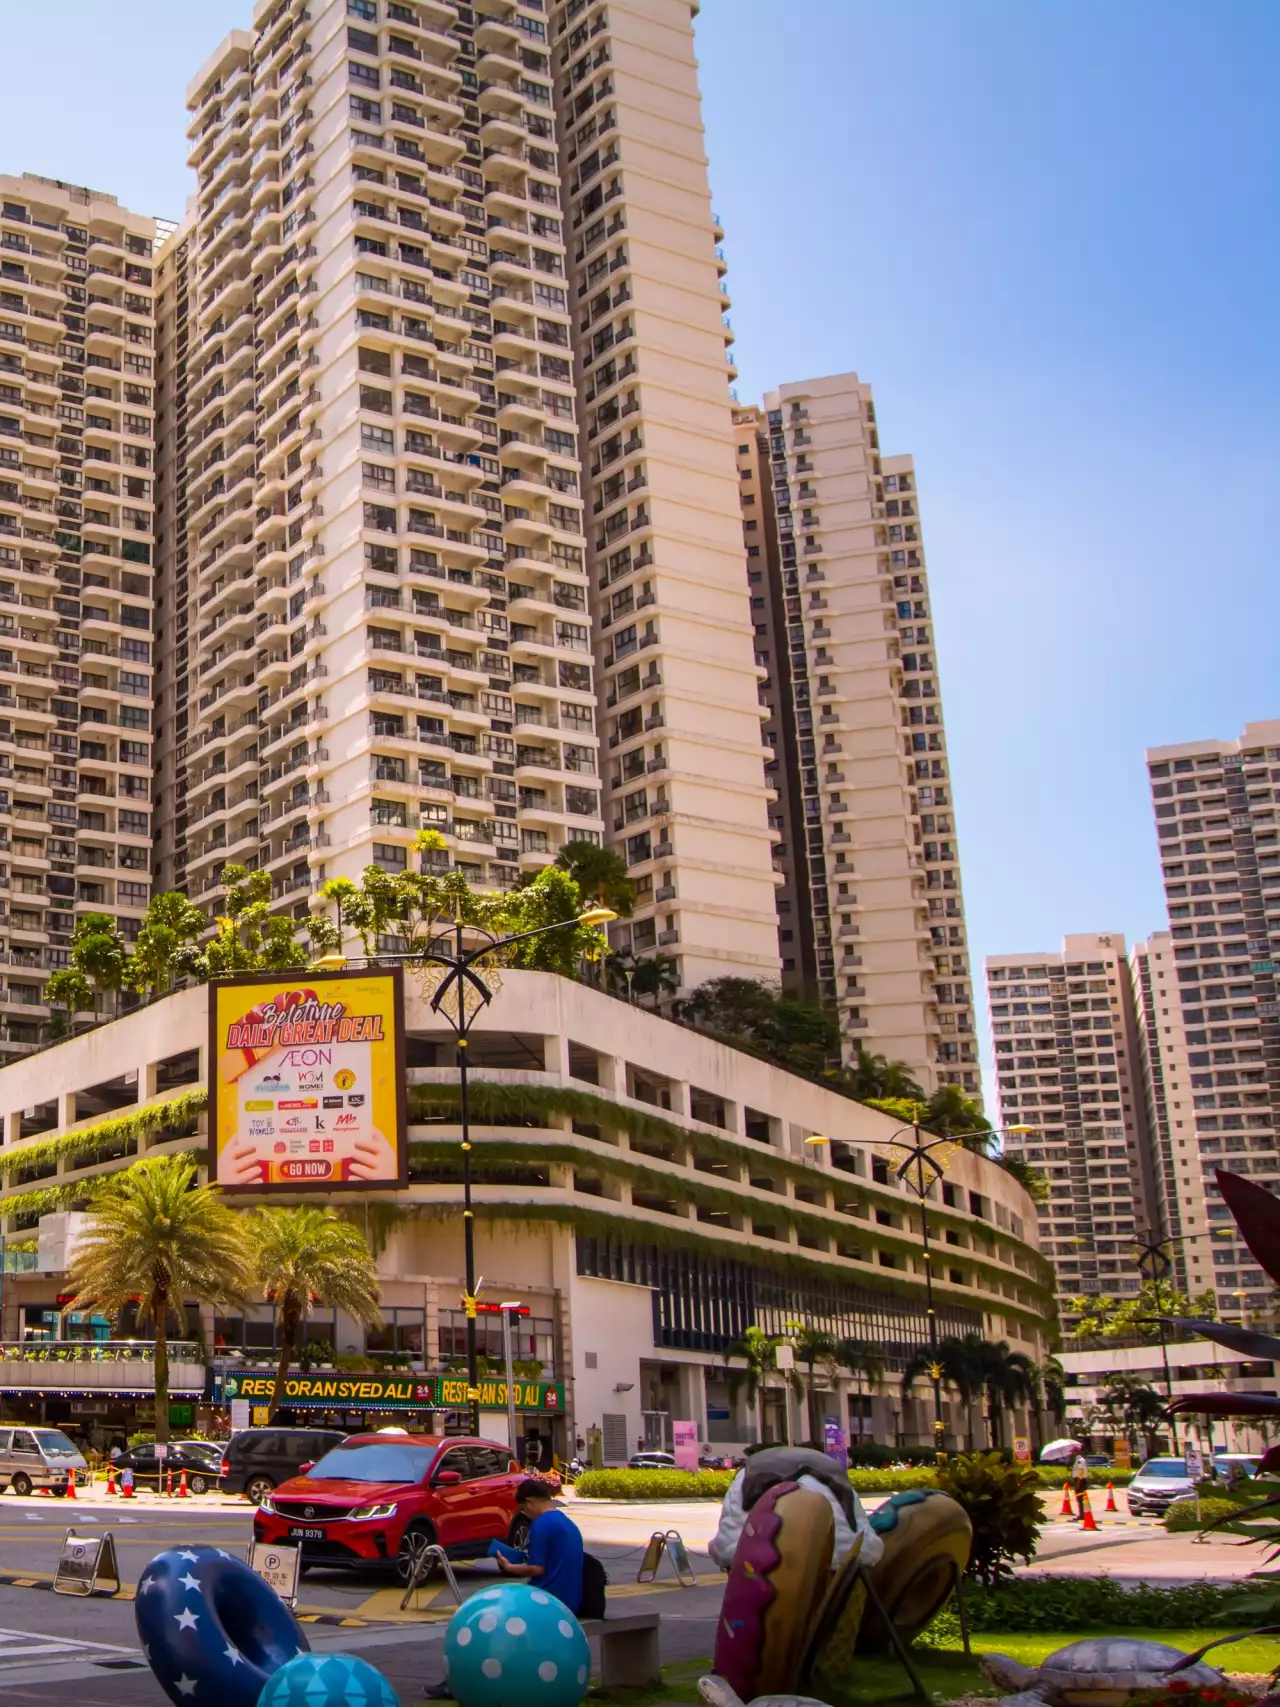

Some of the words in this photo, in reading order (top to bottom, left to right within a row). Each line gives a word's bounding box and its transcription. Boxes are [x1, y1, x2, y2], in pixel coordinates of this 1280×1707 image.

[263, 997, 343, 1029] Beletime
[227, 1024, 277, 1048] DAILY
[280, 1019, 337, 1045] GREAT
[338, 1016, 385, 1042] DEAL
[289, 1163, 301, 1176] GO
[304, 1162, 326, 1176] NOW
[241, 1379, 337, 1397] RESORAN
[338, 1382, 383, 1398] SYED
[384, 1383, 413, 1399] ALI
[416, 1385, 429, 1394] 24
[524, 1384, 540, 1406] ALI
[547, 1393, 556, 1401] 24
